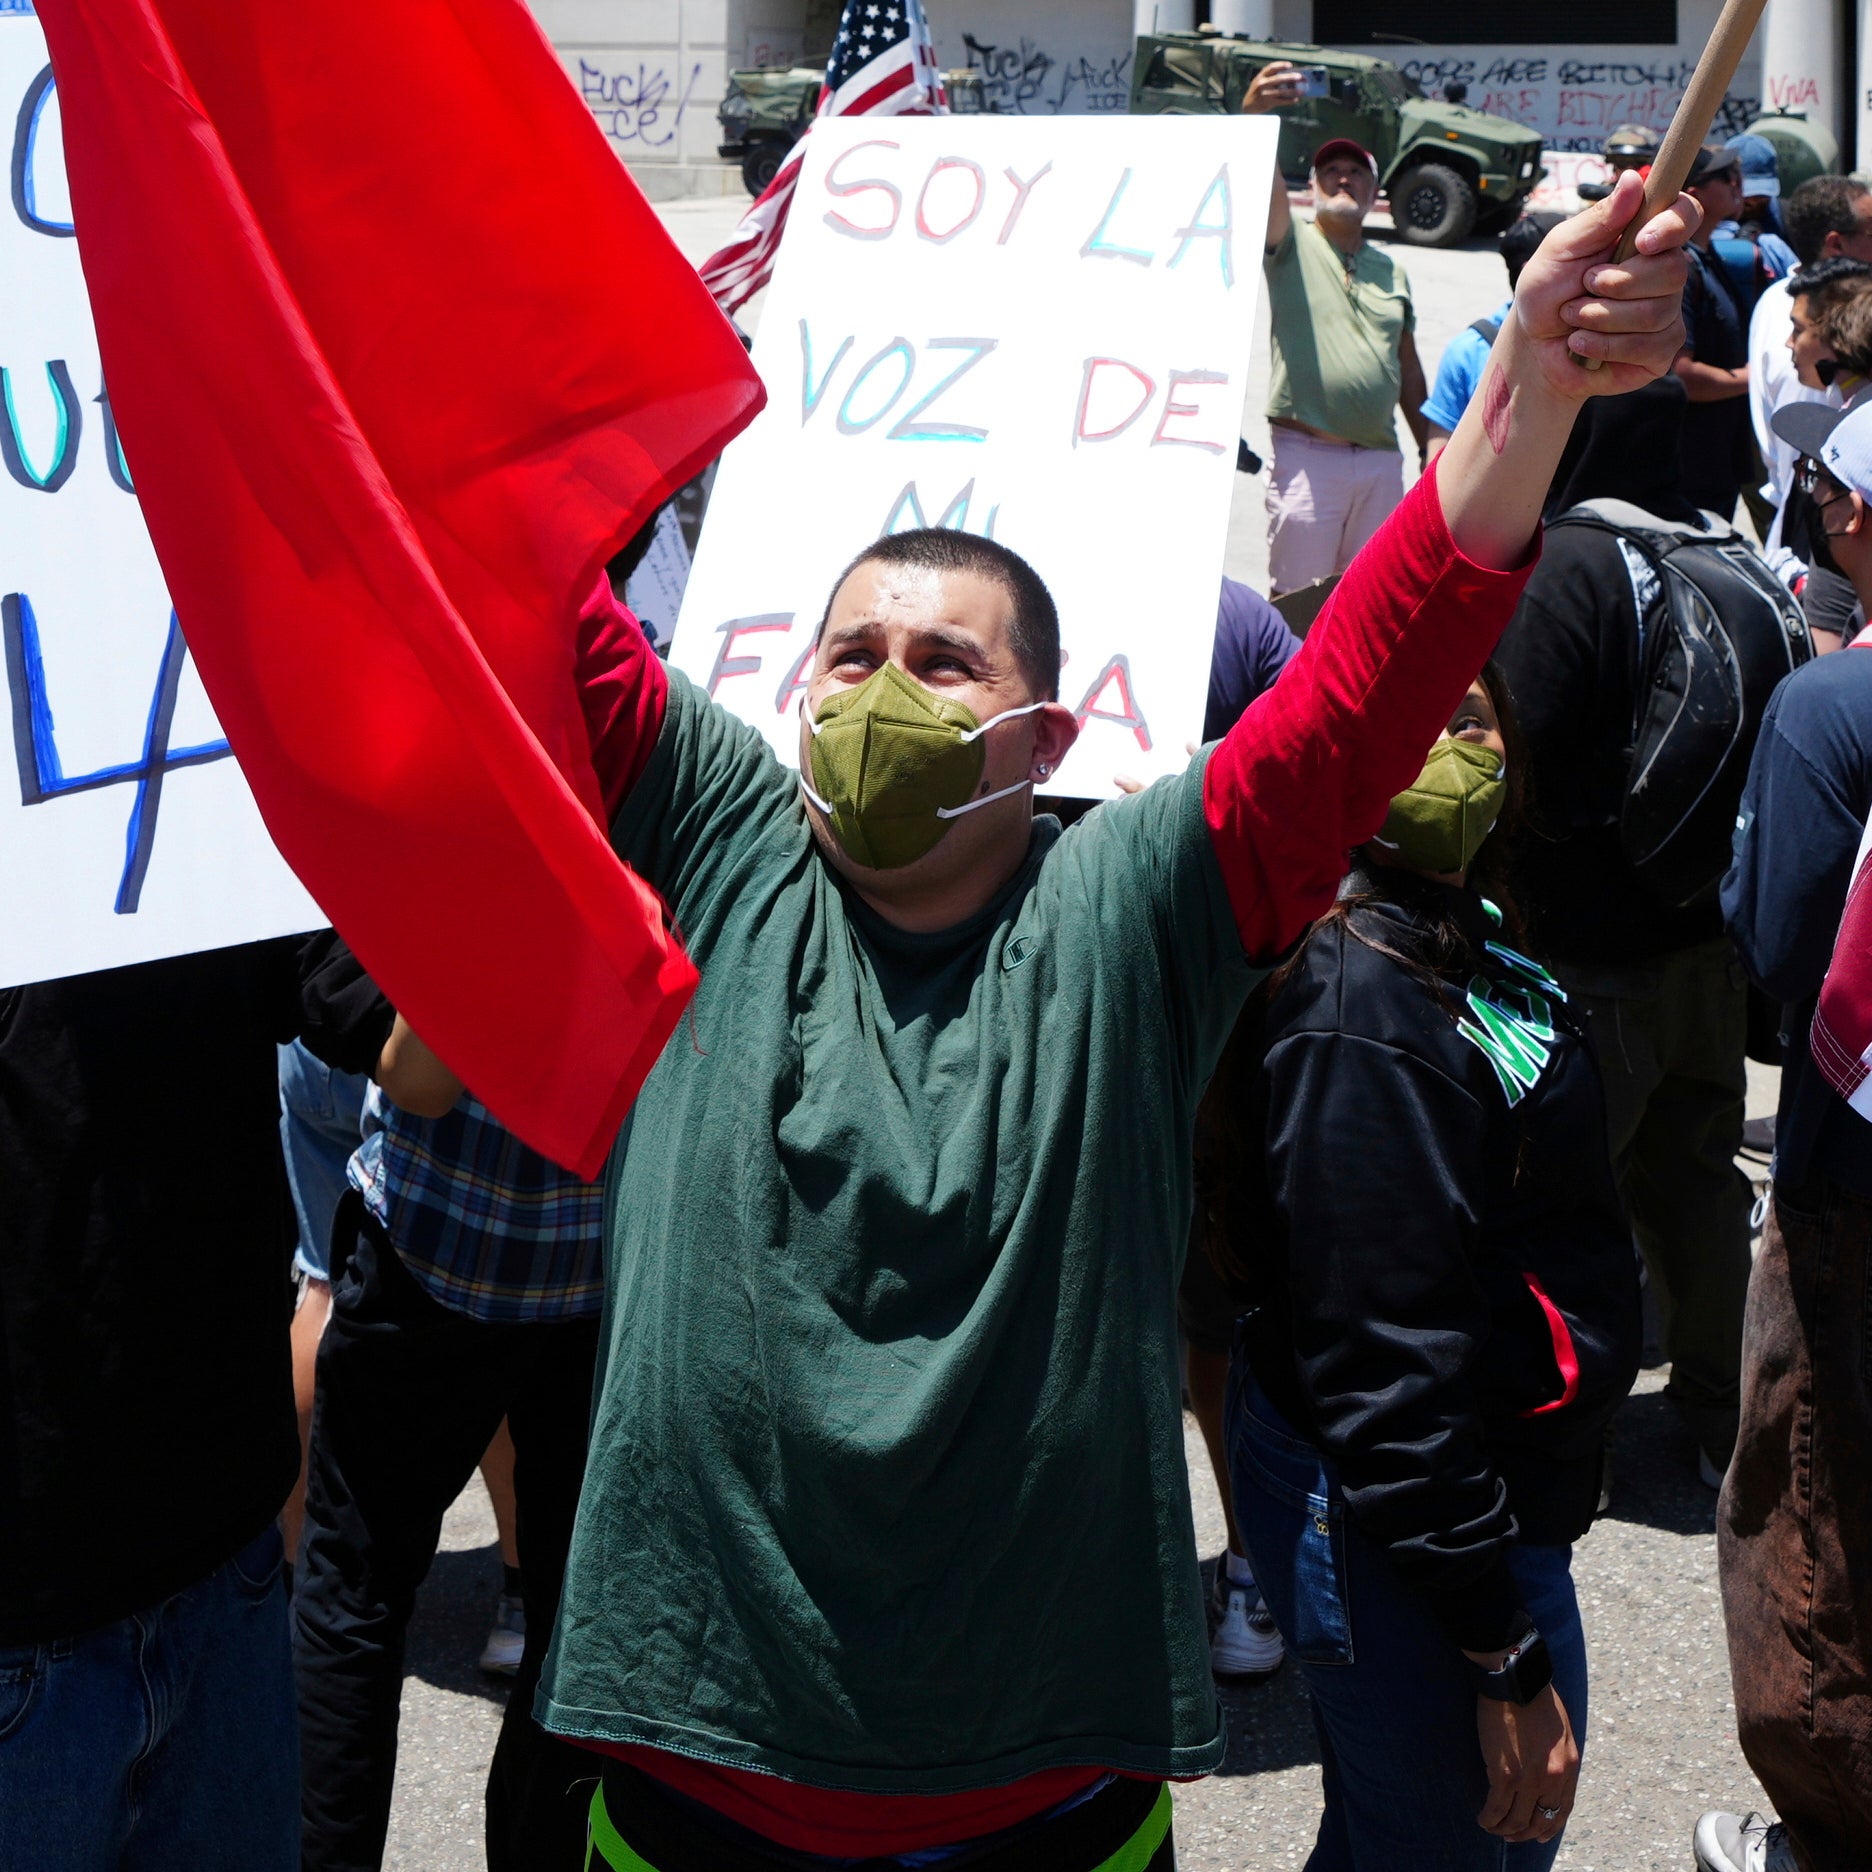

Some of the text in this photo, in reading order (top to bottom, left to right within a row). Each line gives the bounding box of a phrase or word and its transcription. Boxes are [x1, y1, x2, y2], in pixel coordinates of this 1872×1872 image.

[1402, 56, 1476, 87] COPS
[1480, 56, 1548, 85] ARE
[823, 139, 1235, 290] SOY LA
[799, 318, 1229, 454] VOZ DE
